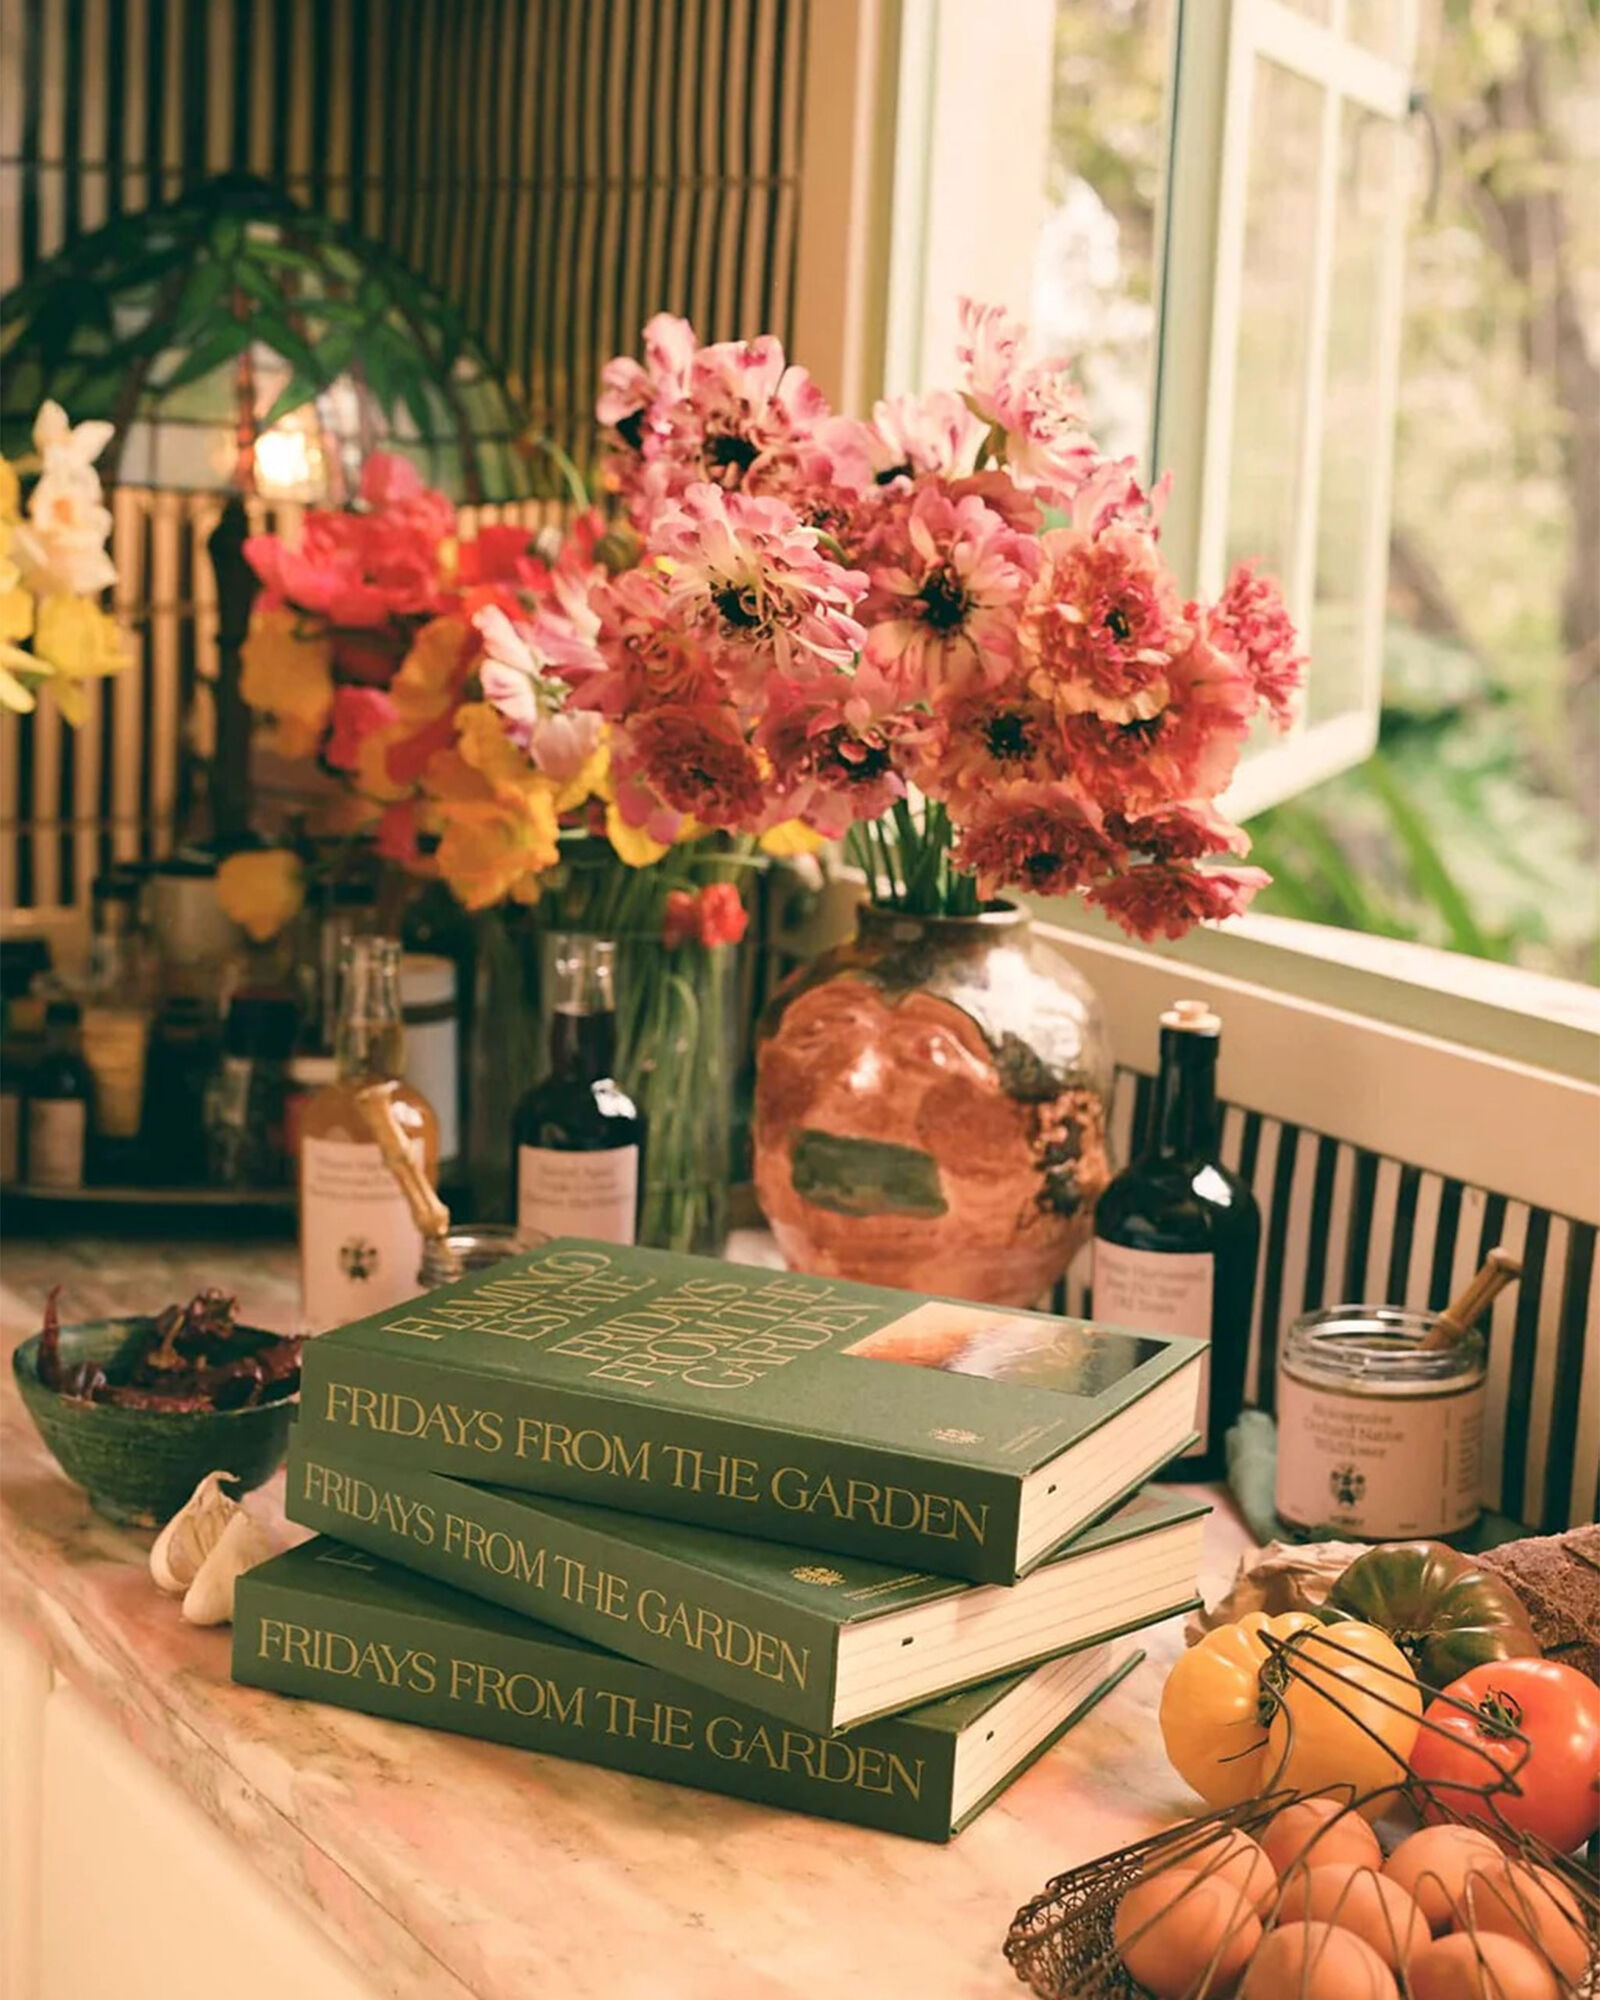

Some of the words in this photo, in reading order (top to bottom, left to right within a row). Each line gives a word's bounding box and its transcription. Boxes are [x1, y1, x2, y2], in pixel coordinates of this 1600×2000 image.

[381, 1250, 612, 1341] FLAMINGO
[473, 1271, 657, 1341] ESTATE
[545, 1278, 748, 1362] FRIDAYS
[588, 1320, 758, 1388] FROM
[714, 1279, 836, 1321] THE
[681, 1296, 884, 1389] GARDEN
[324, 1382, 504, 1452] FRIDAYS
[514, 1416, 652, 1482] FROM
[661, 1445, 761, 1502] THE
[770, 1466, 990, 1547] GARDEN
[303, 1461, 436, 1545] FRIDAYS
[443, 1512, 548, 1589] FROM
[553, 1554, 630, 1621] THE
[637, 1588, 812, 1690] GARDEN
[257, 1617, 438, 1694] FRIDAYS
[450, 1659, 586, 1728] FROM
[595, 1691, 695, 1751] THE
[705, 1715, 926, 1801] GARDEN
